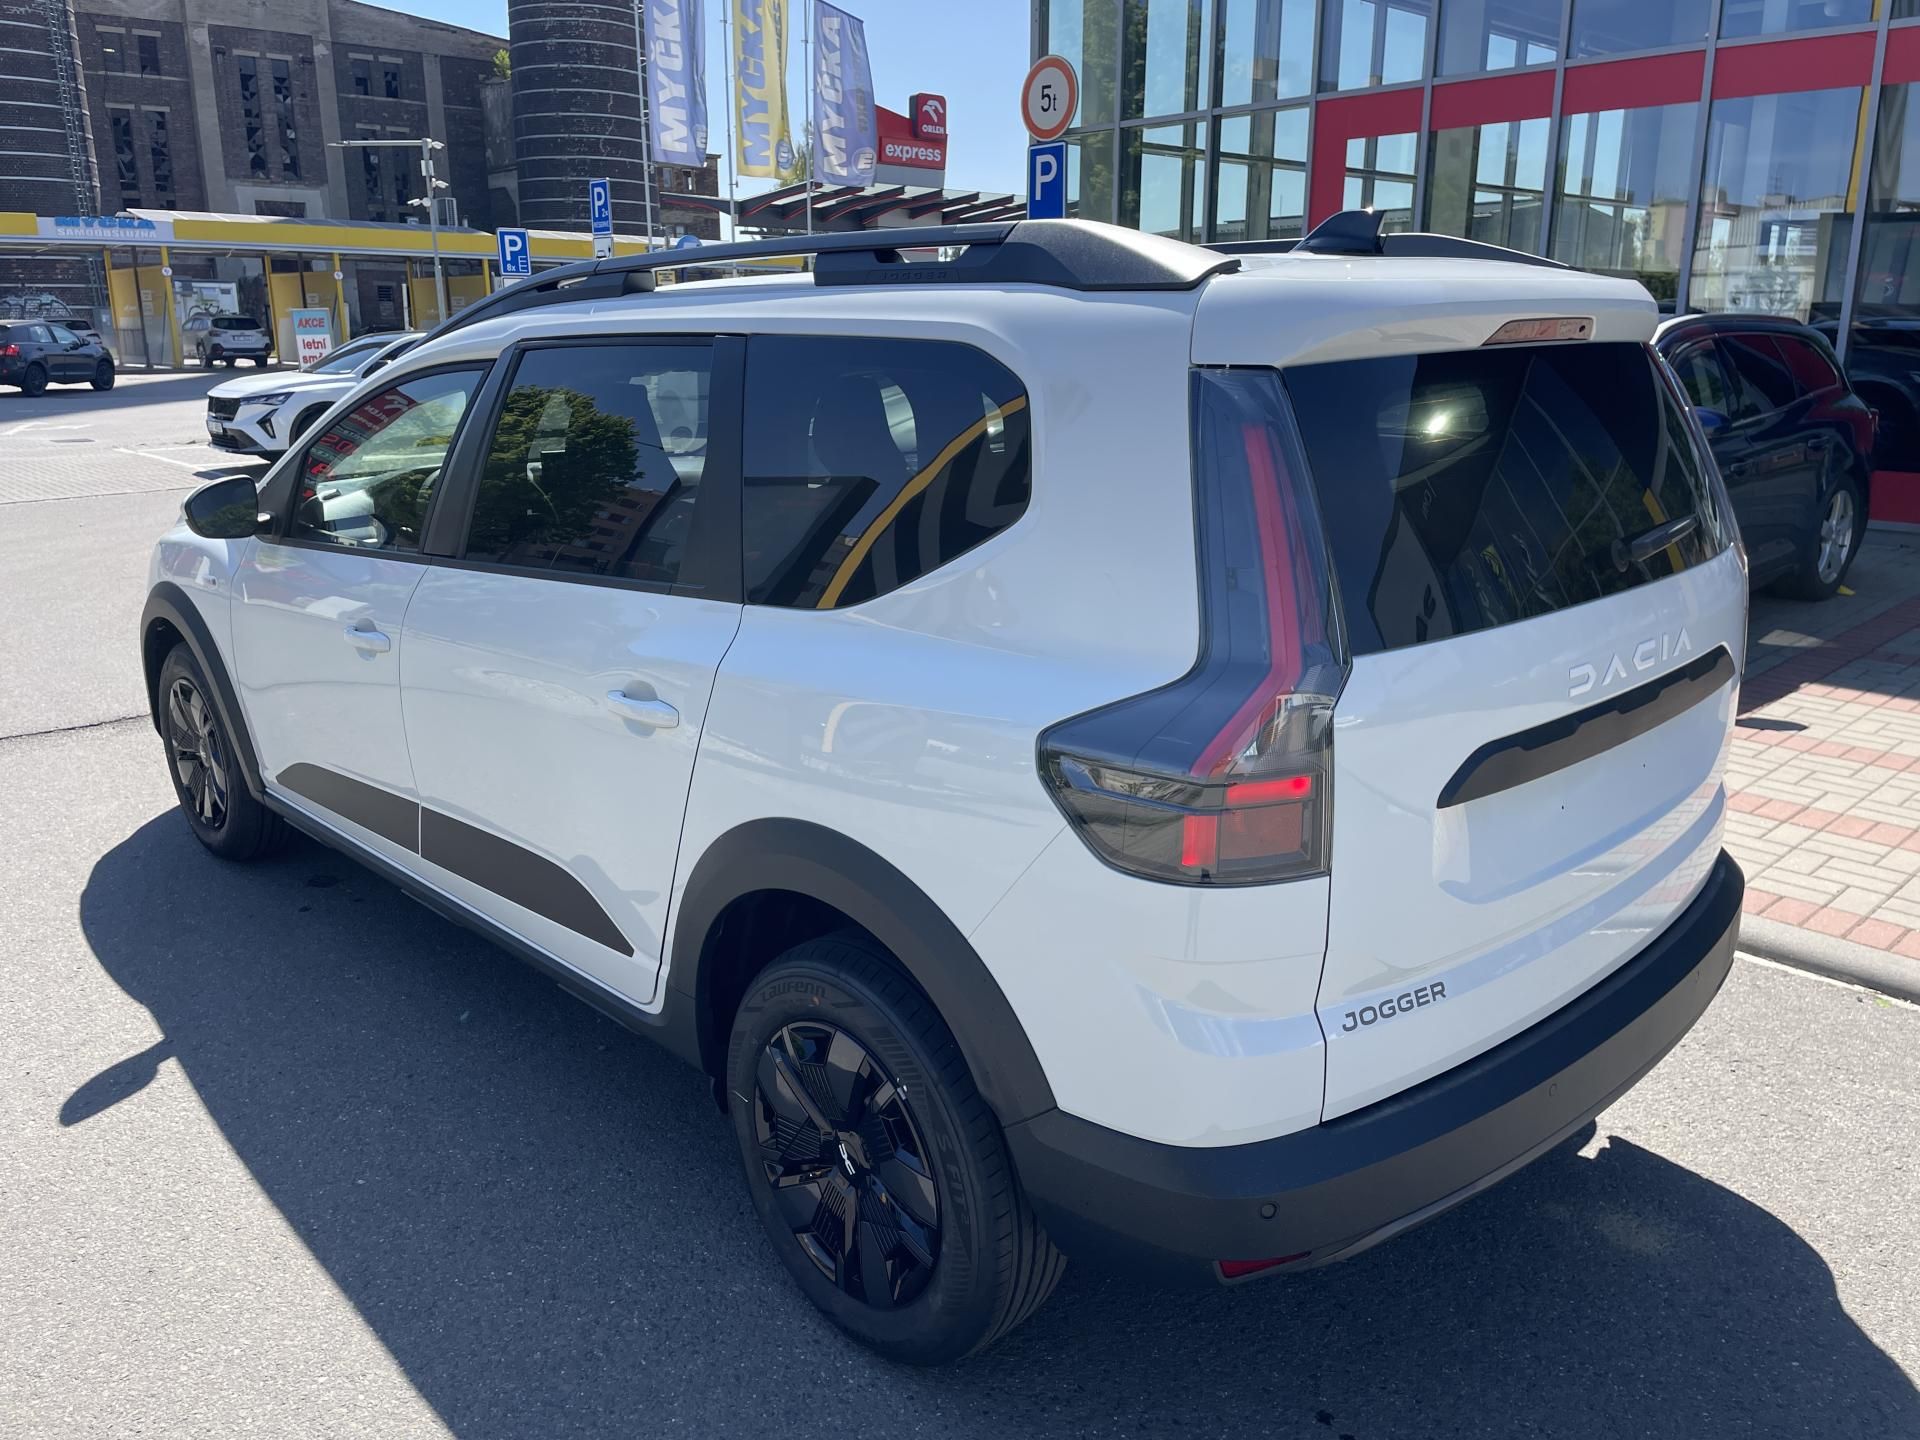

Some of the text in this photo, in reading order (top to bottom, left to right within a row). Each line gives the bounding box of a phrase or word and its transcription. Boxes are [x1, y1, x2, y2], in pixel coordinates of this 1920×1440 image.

[817, 17, 848, 177] MYČKA
[922, 124, 945, 135] ORLEN
[885, 143, 942, 162] express
[1035, 154, 1058, 201] P
[593, 187, 605, 218] P
[504, 234, 522, 262] P
[298, 317, 325, 329] AKCE
[1569, 626, 1692, 698] DACIA
[1342, 981, 1447, 1032] JOGGER
